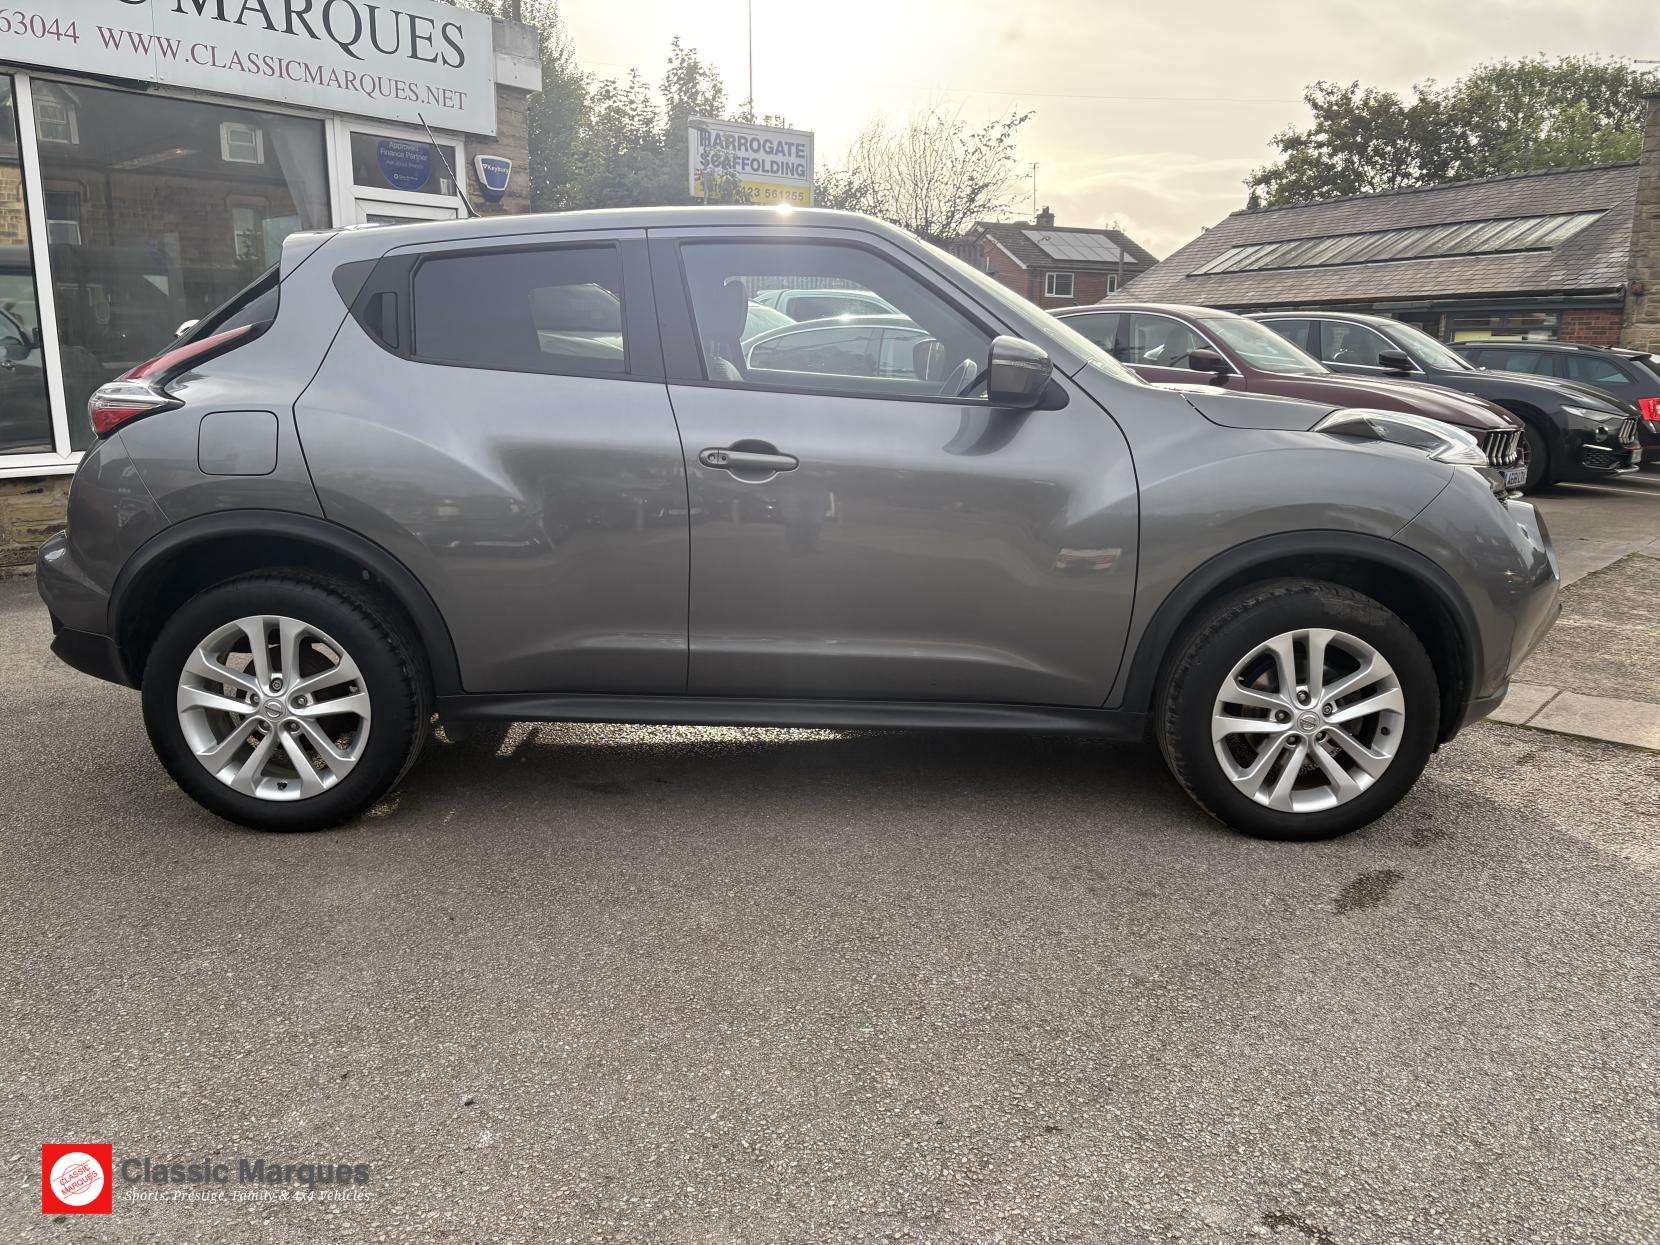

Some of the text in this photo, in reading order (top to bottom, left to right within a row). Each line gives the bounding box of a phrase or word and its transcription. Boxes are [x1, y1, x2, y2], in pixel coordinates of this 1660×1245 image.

[95, 26, 468, 110] WWW.CLASSICMARQUES.NET
[699, 129, 806, 159] HARROGATE
[699, 152, 806, 178] SCAFFOLDING
[764, 187, 805, 202] 561255
